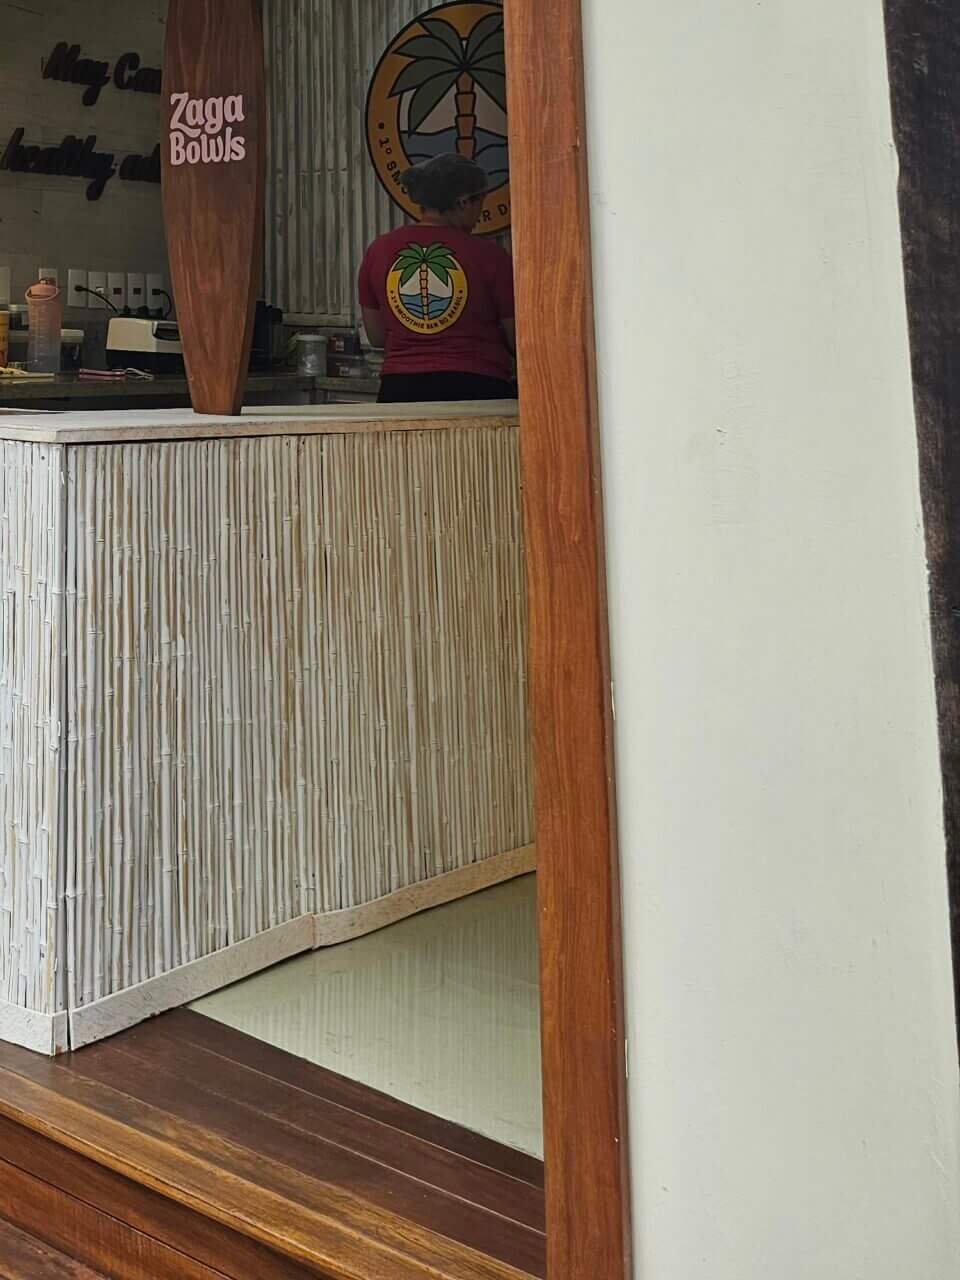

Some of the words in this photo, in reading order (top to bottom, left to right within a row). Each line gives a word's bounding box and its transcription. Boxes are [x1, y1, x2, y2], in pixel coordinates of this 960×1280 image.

[169, 91, 245, 138] Zaga
[169, 126, 246, 166] Bowls
[395, 304, 425, 329] SMOOTHIE
